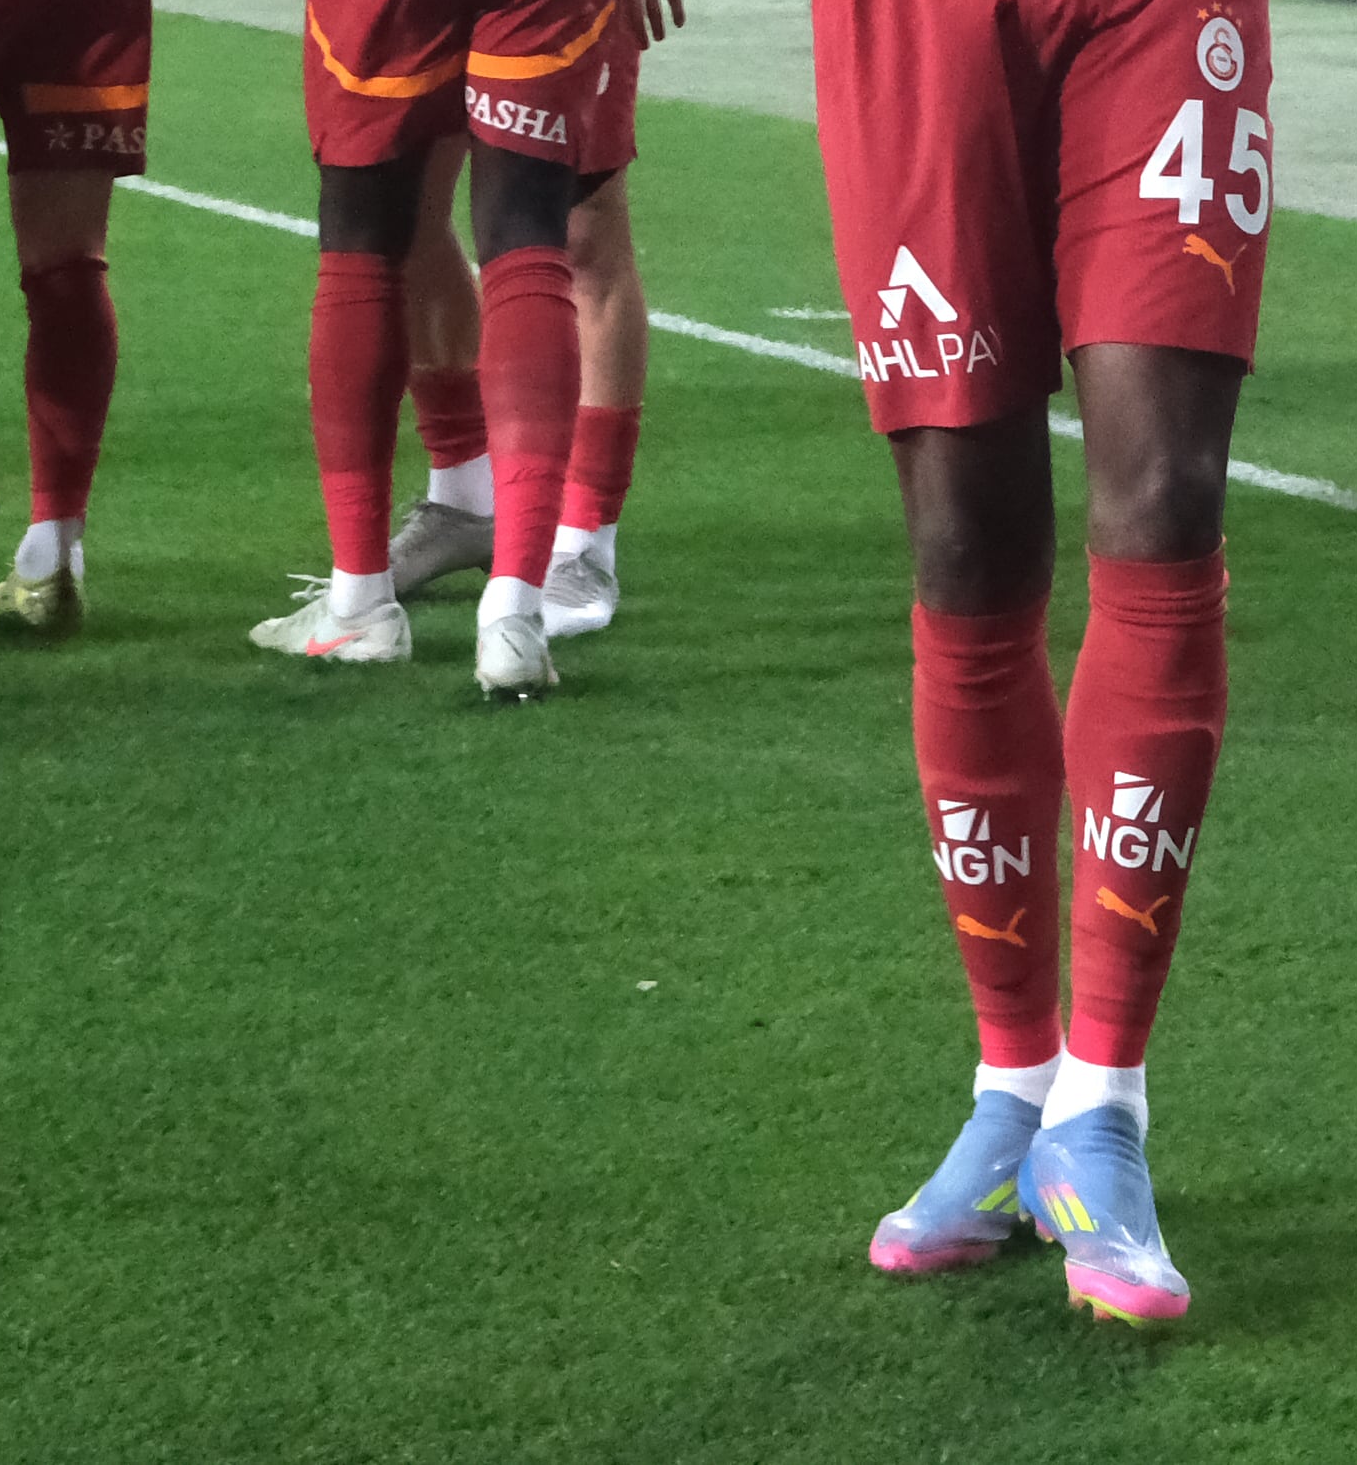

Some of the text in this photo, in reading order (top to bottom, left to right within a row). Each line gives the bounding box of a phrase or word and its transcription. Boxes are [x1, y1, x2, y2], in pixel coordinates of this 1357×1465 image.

[464, 85, 568, 145] PASHA
[1139, 99, 1269, 235] 45
[932, 835, 1030, 886] NGN
[1082, 806, 1195, 872] NGN
